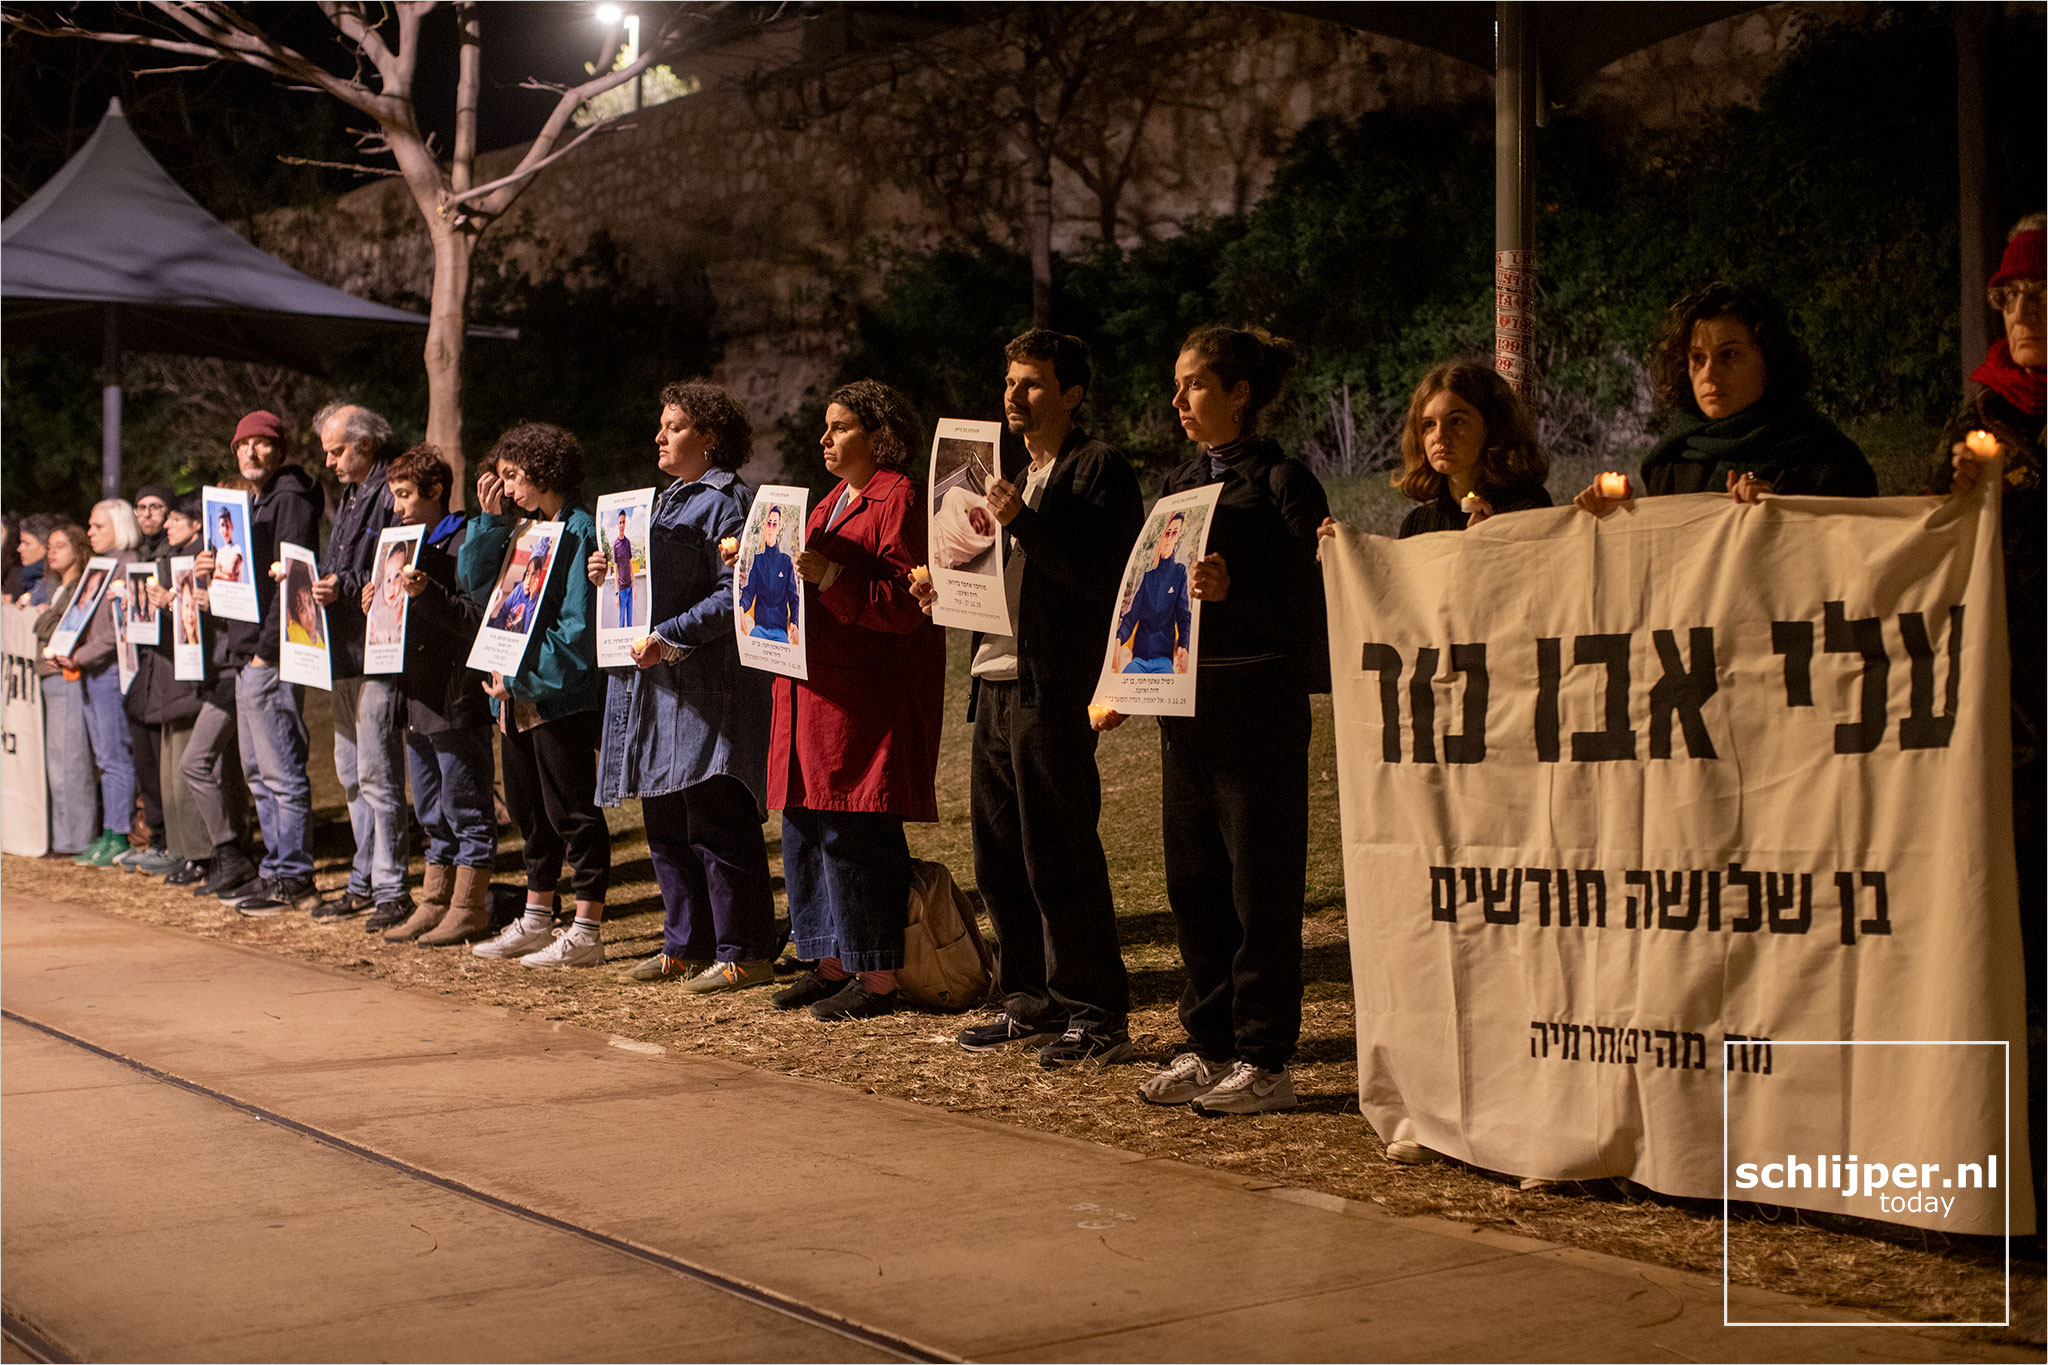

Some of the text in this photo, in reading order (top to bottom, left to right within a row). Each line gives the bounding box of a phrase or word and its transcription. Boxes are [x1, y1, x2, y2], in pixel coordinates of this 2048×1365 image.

[1362, 601, 1966, 765] עלי אבו נור
[1429, 863, 1892, 945] בן שלושה חודשים
[1530, 1021, 1706, 1070] מהיפותרמיה
